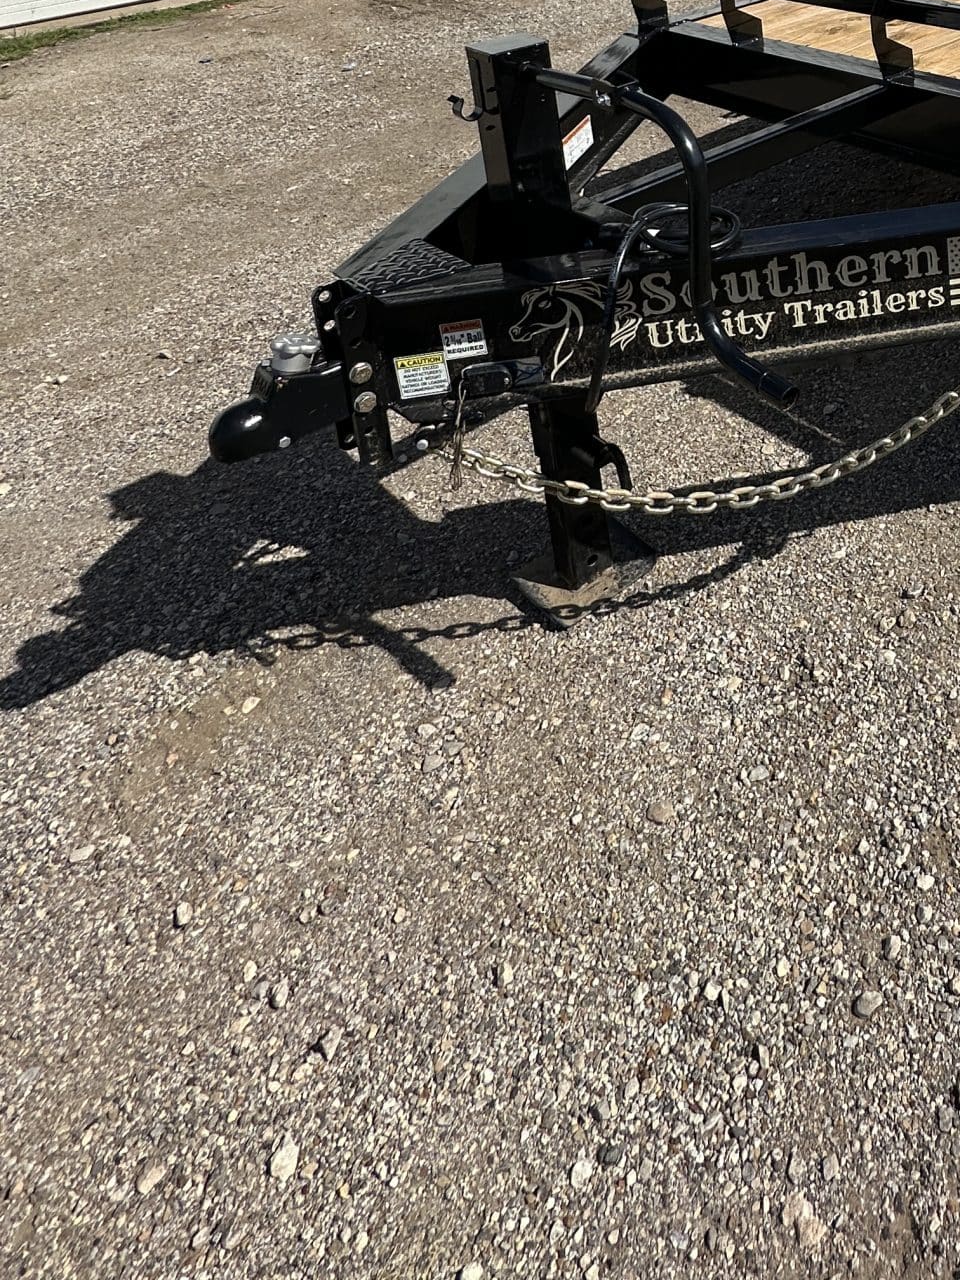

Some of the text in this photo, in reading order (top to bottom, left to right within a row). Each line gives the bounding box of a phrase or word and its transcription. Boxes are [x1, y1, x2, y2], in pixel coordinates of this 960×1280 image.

[644, 285, 946, 348] Utiity Trailers
[466, 331, 482, 344] Ball
[447, 344, 484, 354] REQUIRED
[406, 357, 441, 367] CAUTION
